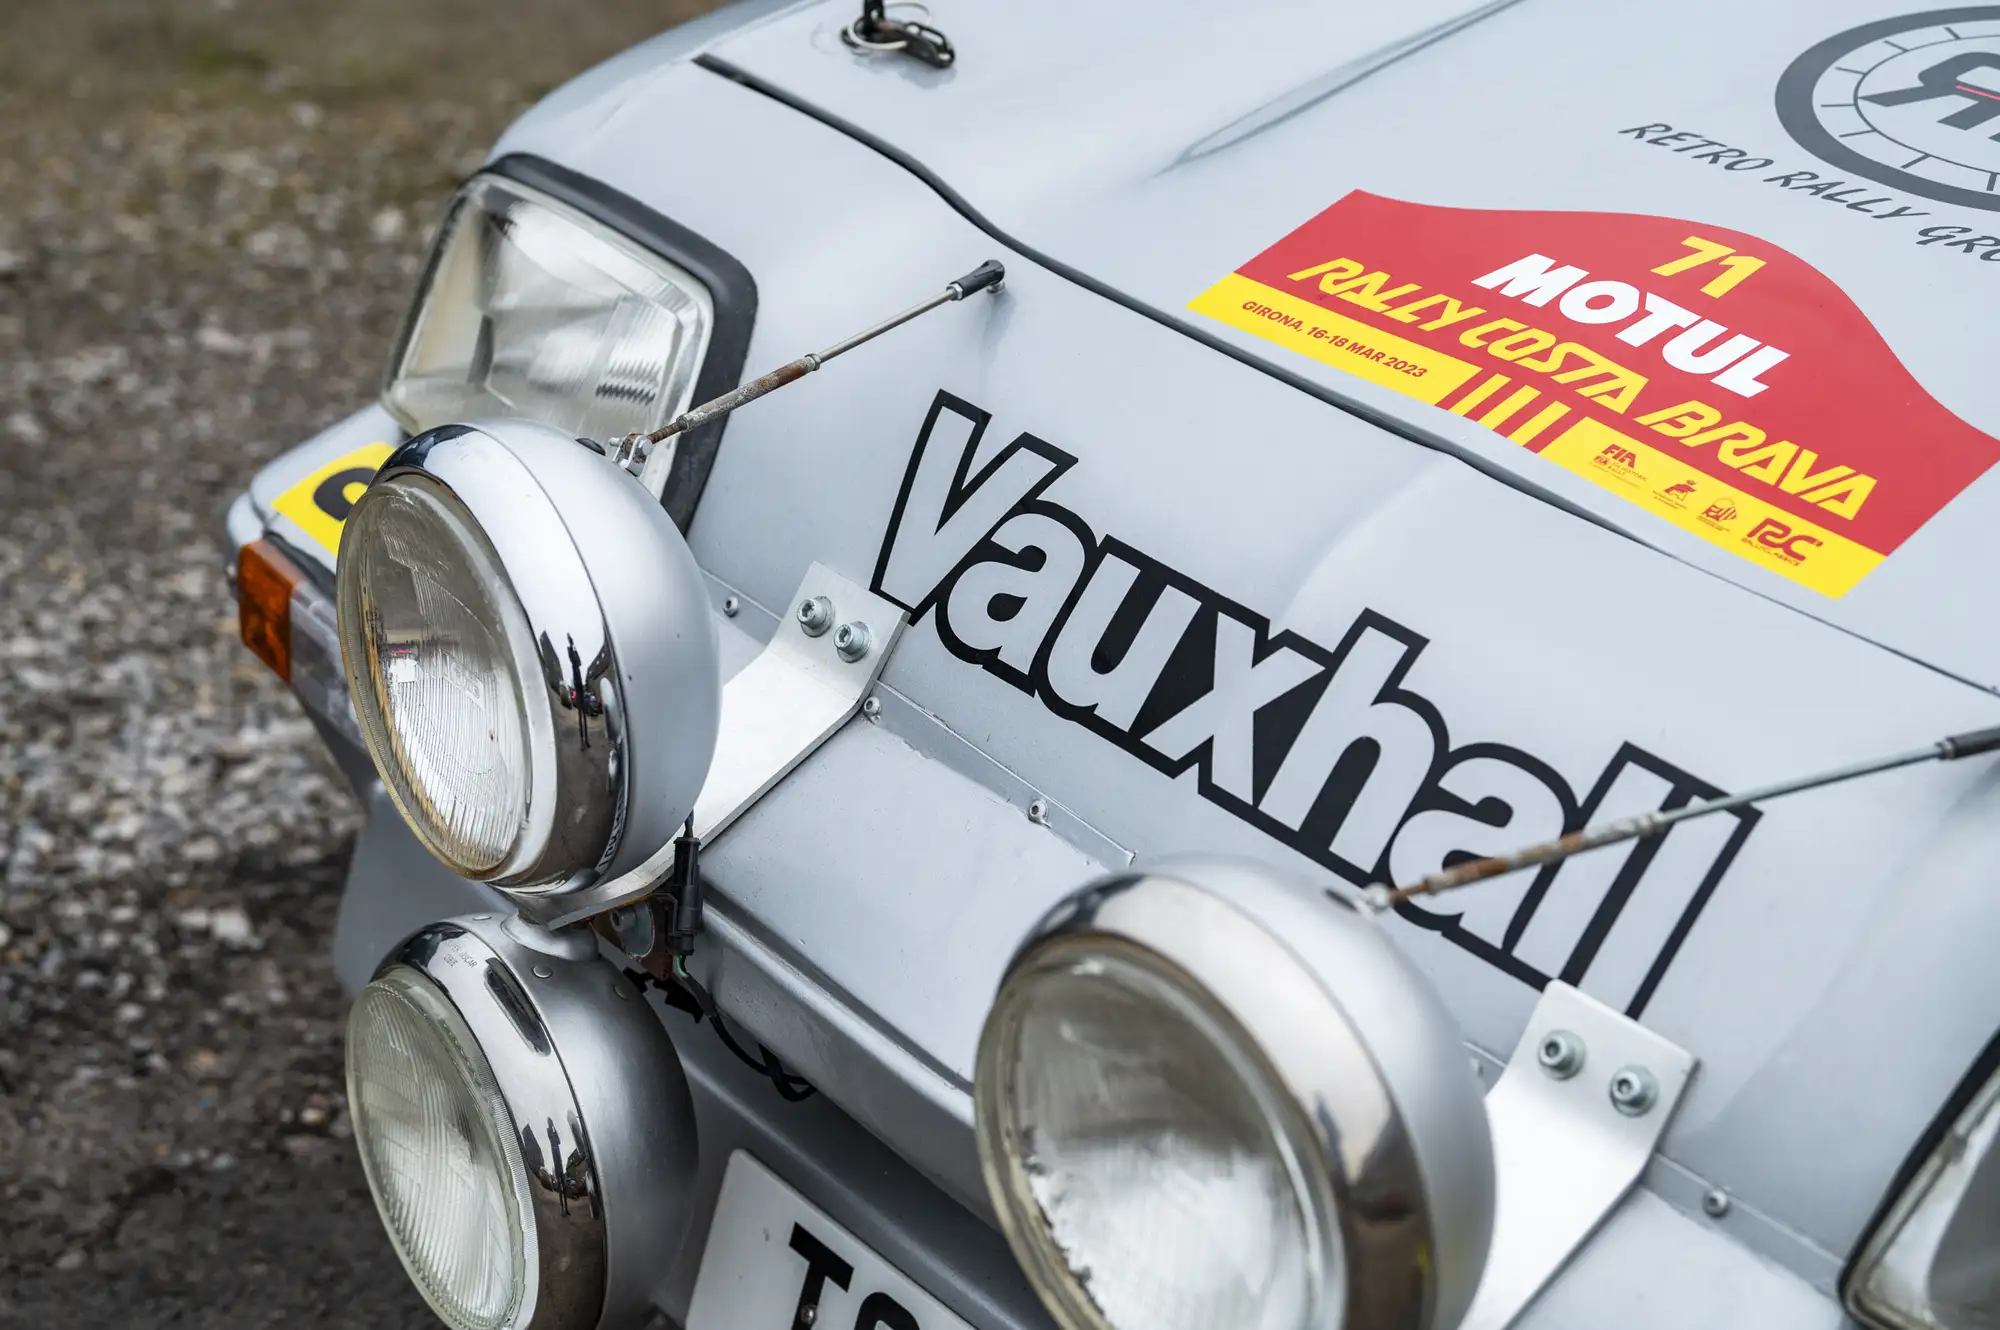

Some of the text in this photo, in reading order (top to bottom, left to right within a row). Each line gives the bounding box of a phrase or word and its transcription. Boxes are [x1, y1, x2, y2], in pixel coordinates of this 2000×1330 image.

[1618, 123, 1774, 171] RETRO
[1762, 171, 1931, 219] RALLY
[1650, 235, 1767, 299] 71
[1242, 300, 1428, 378] GIRONA, 16-18 MAR 2023
[1471, 253, 1791, 398] MOTUL
[1286, 257, 1878, 520] RALLY COSTA BRAVA
[1601, 444, 1637, 469] FIA
[870, 388, 1763, 1020] Vauxhall
